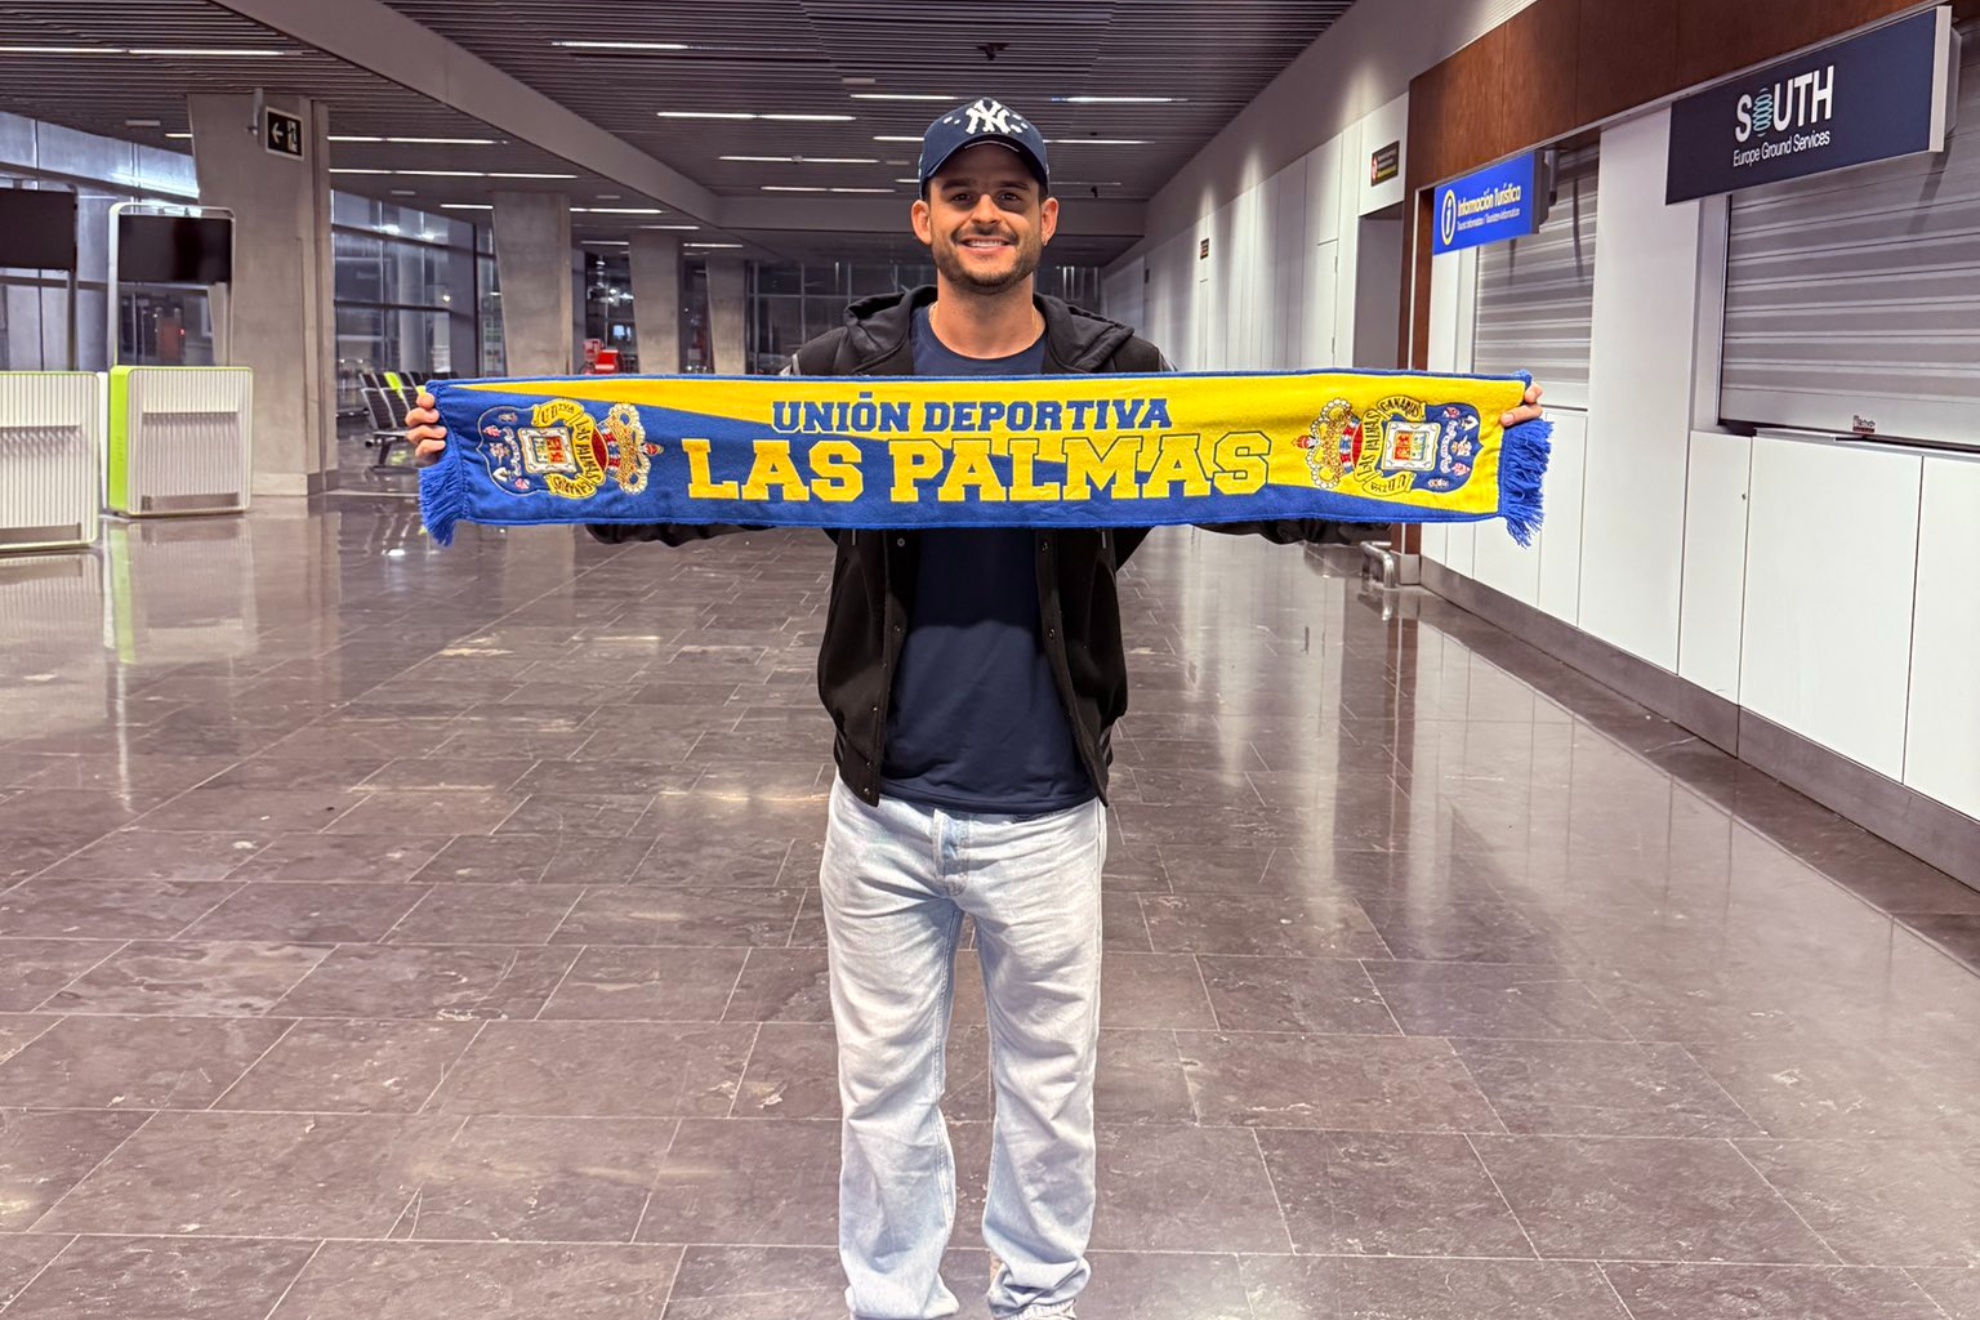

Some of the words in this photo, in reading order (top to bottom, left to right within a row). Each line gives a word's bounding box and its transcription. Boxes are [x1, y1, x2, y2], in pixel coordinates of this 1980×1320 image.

[1735, 65, 1834, 142] SOUTH
[1733, 148, 1760, 167] Europe
[1761, 136, 1792, 159] Ground
[1793, 130, 1830, 152] Services
[1457, 187, 1494, 217] Información
[922, 398, 1173, 433] DEPORTIVA
[681, 438, 863, 502] LAS
[889, 430, 1272, 502] PALMAS
